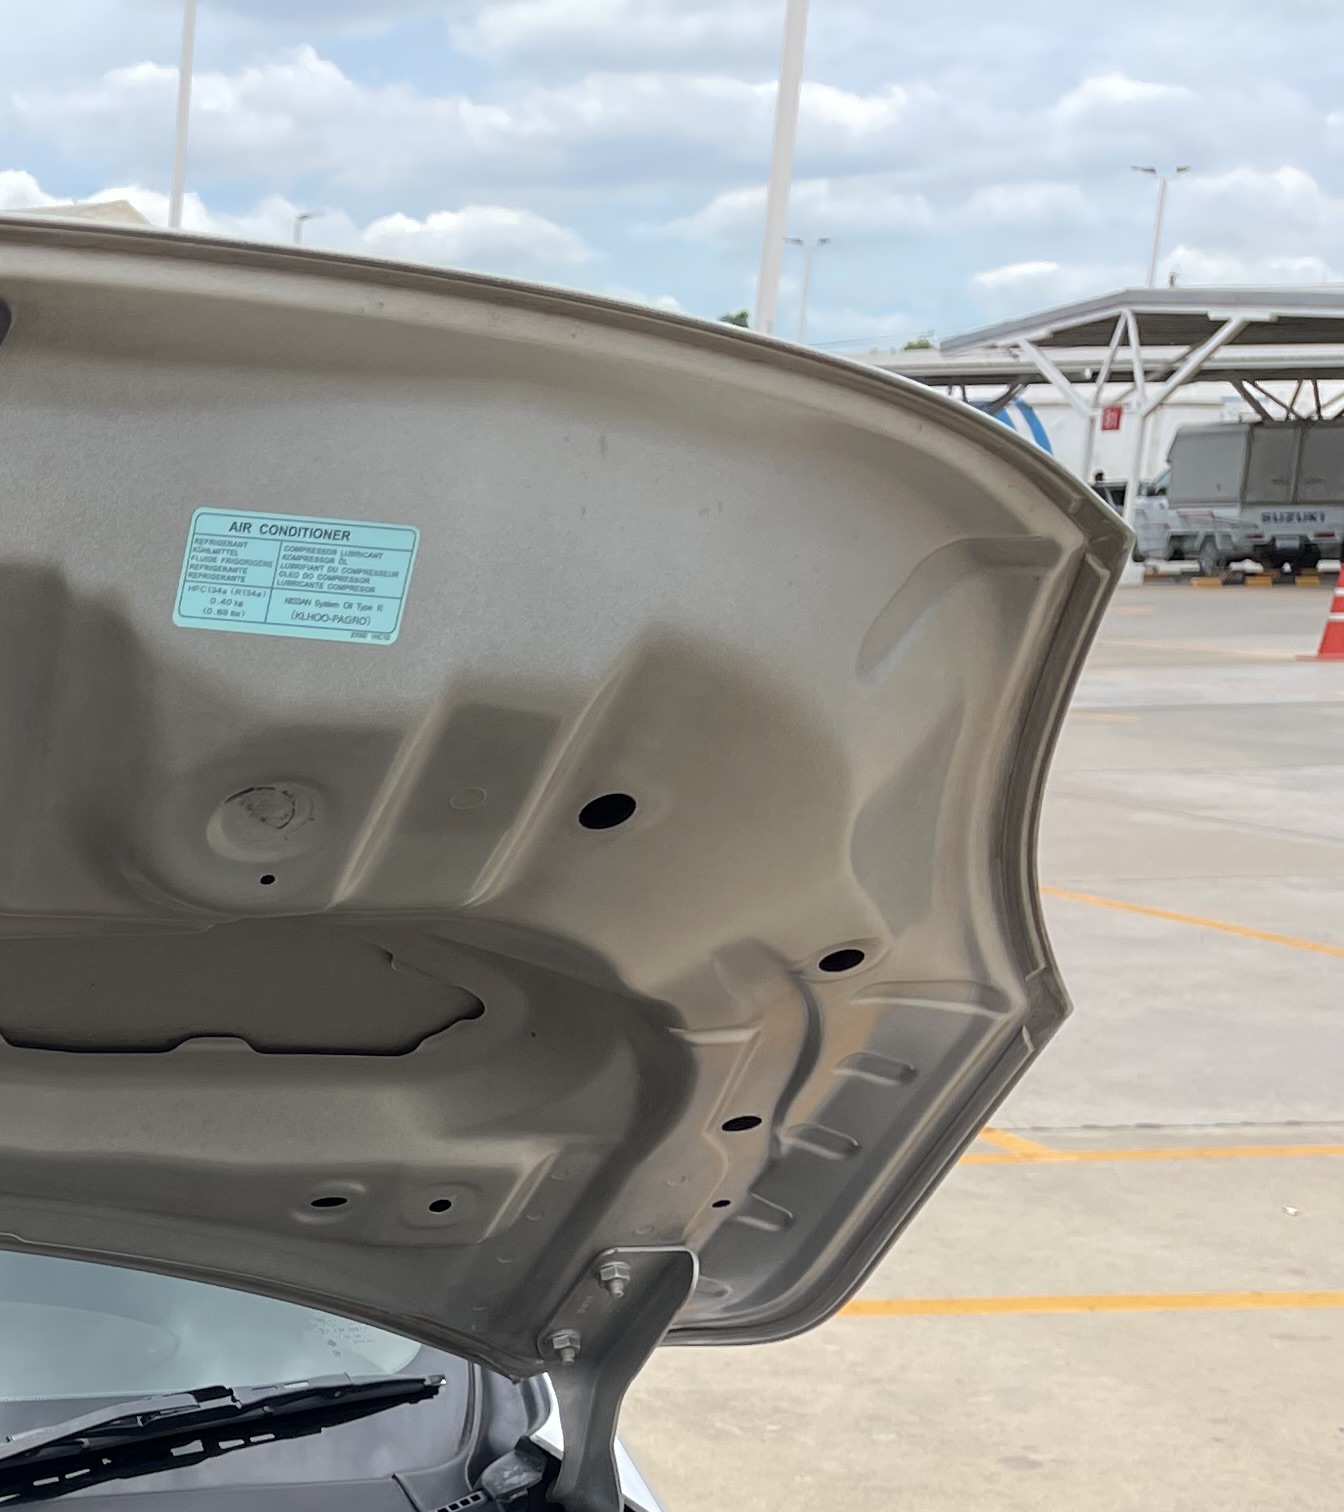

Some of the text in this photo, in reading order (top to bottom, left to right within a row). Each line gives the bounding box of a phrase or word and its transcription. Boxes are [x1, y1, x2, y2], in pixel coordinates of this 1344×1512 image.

[1261, 511, 1325, 523] SUZUKI
[228, 521, 351, 542] AIR CONDITIONER
